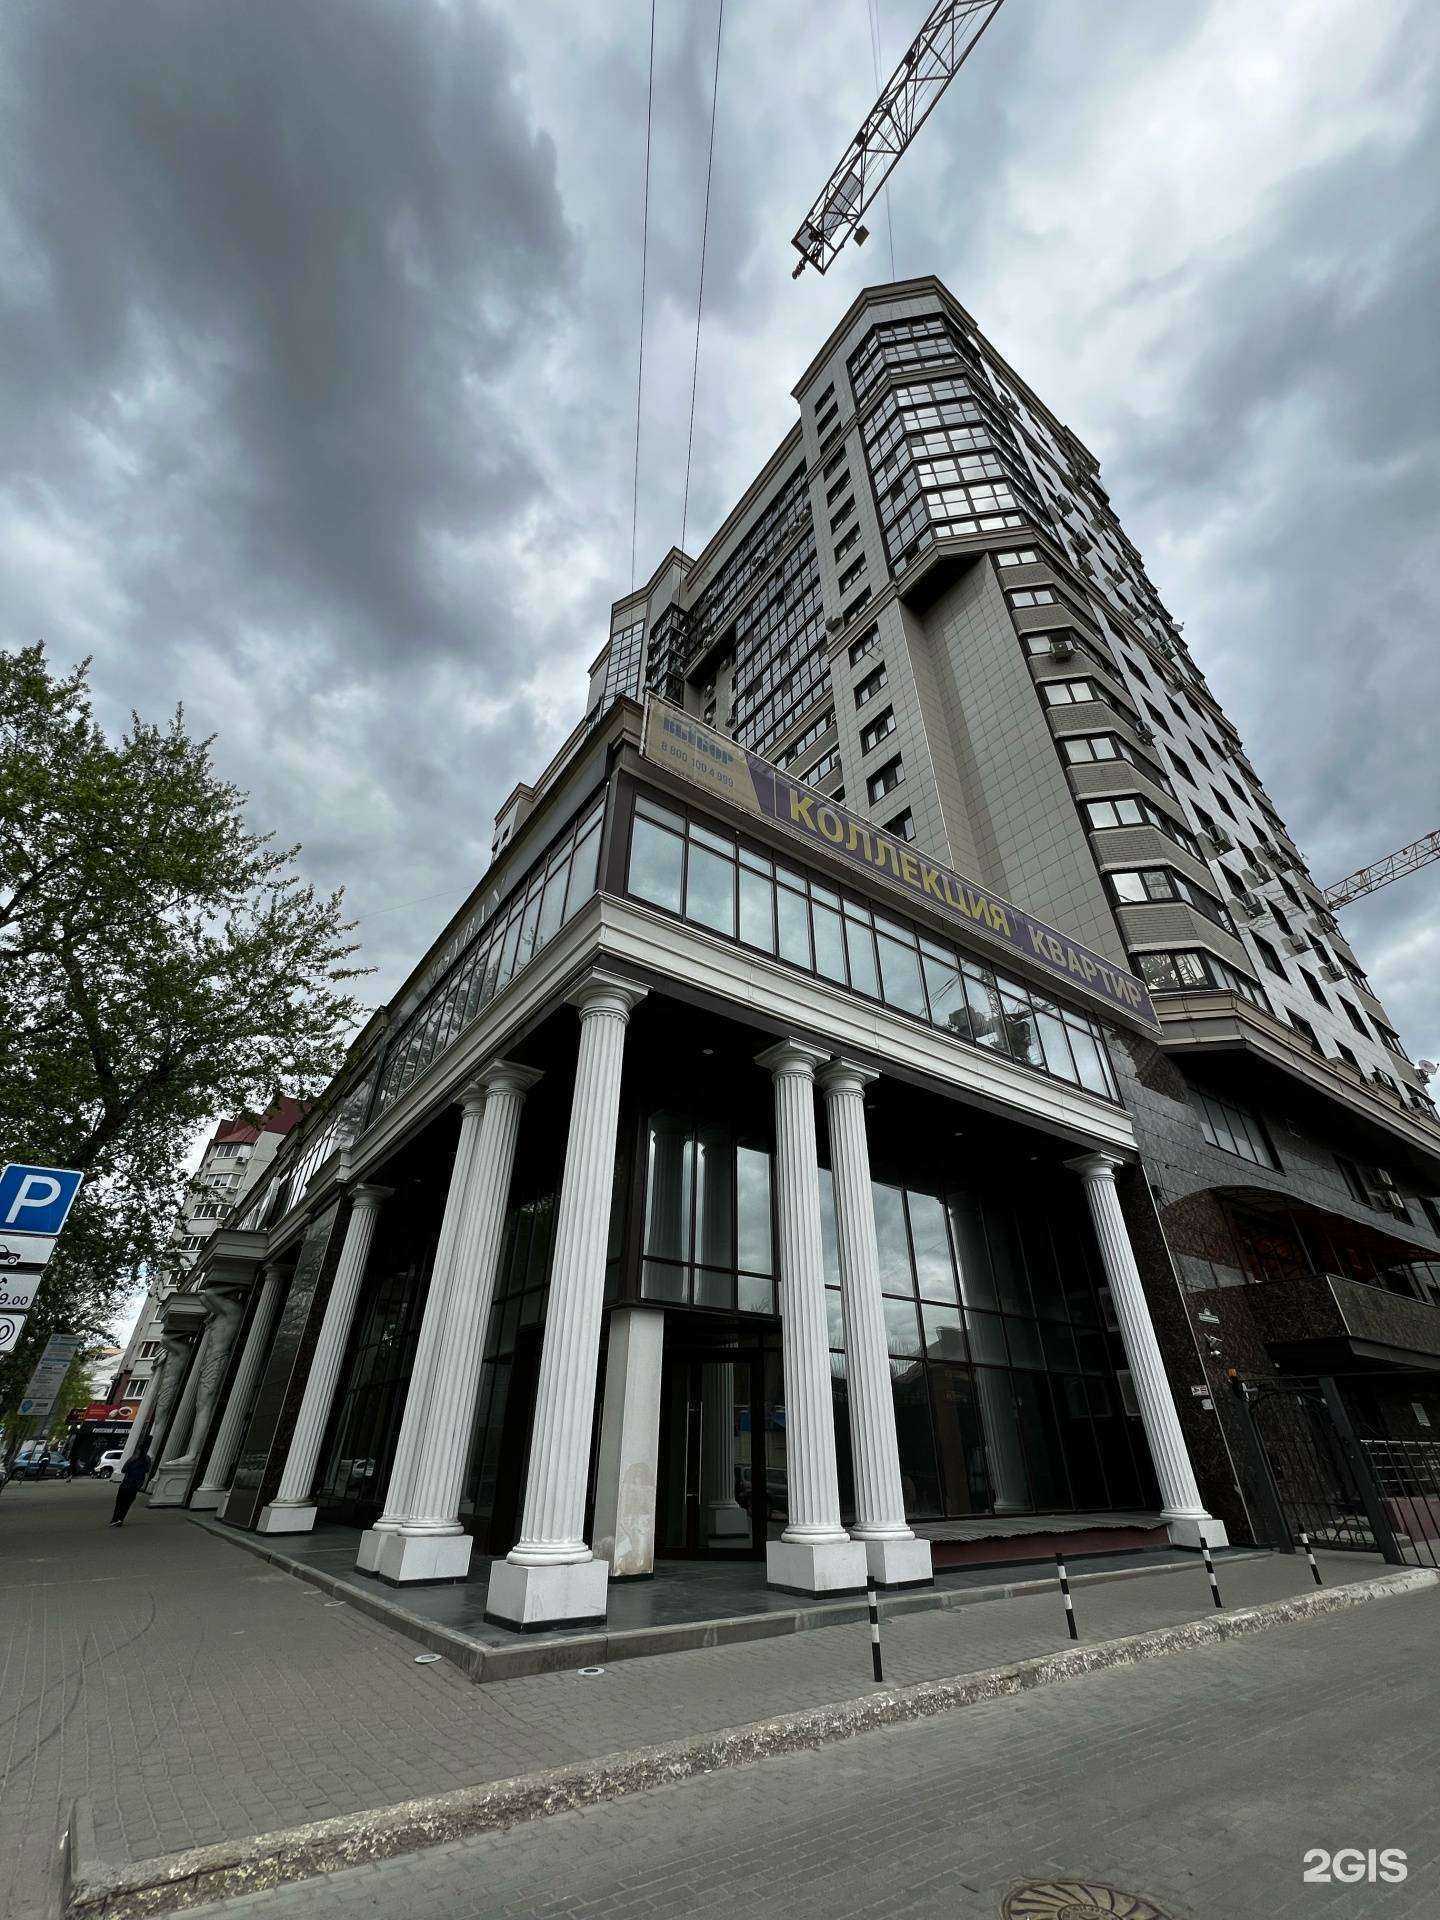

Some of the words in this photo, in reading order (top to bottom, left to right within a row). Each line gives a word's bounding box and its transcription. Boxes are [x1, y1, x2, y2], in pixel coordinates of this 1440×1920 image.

[788, 788, 1012, 938] КОЛЛЕКЦИЯ
[1027, 924, 1142, 1009] КВАРТИР
[5, 1174, 62, 1223] P
